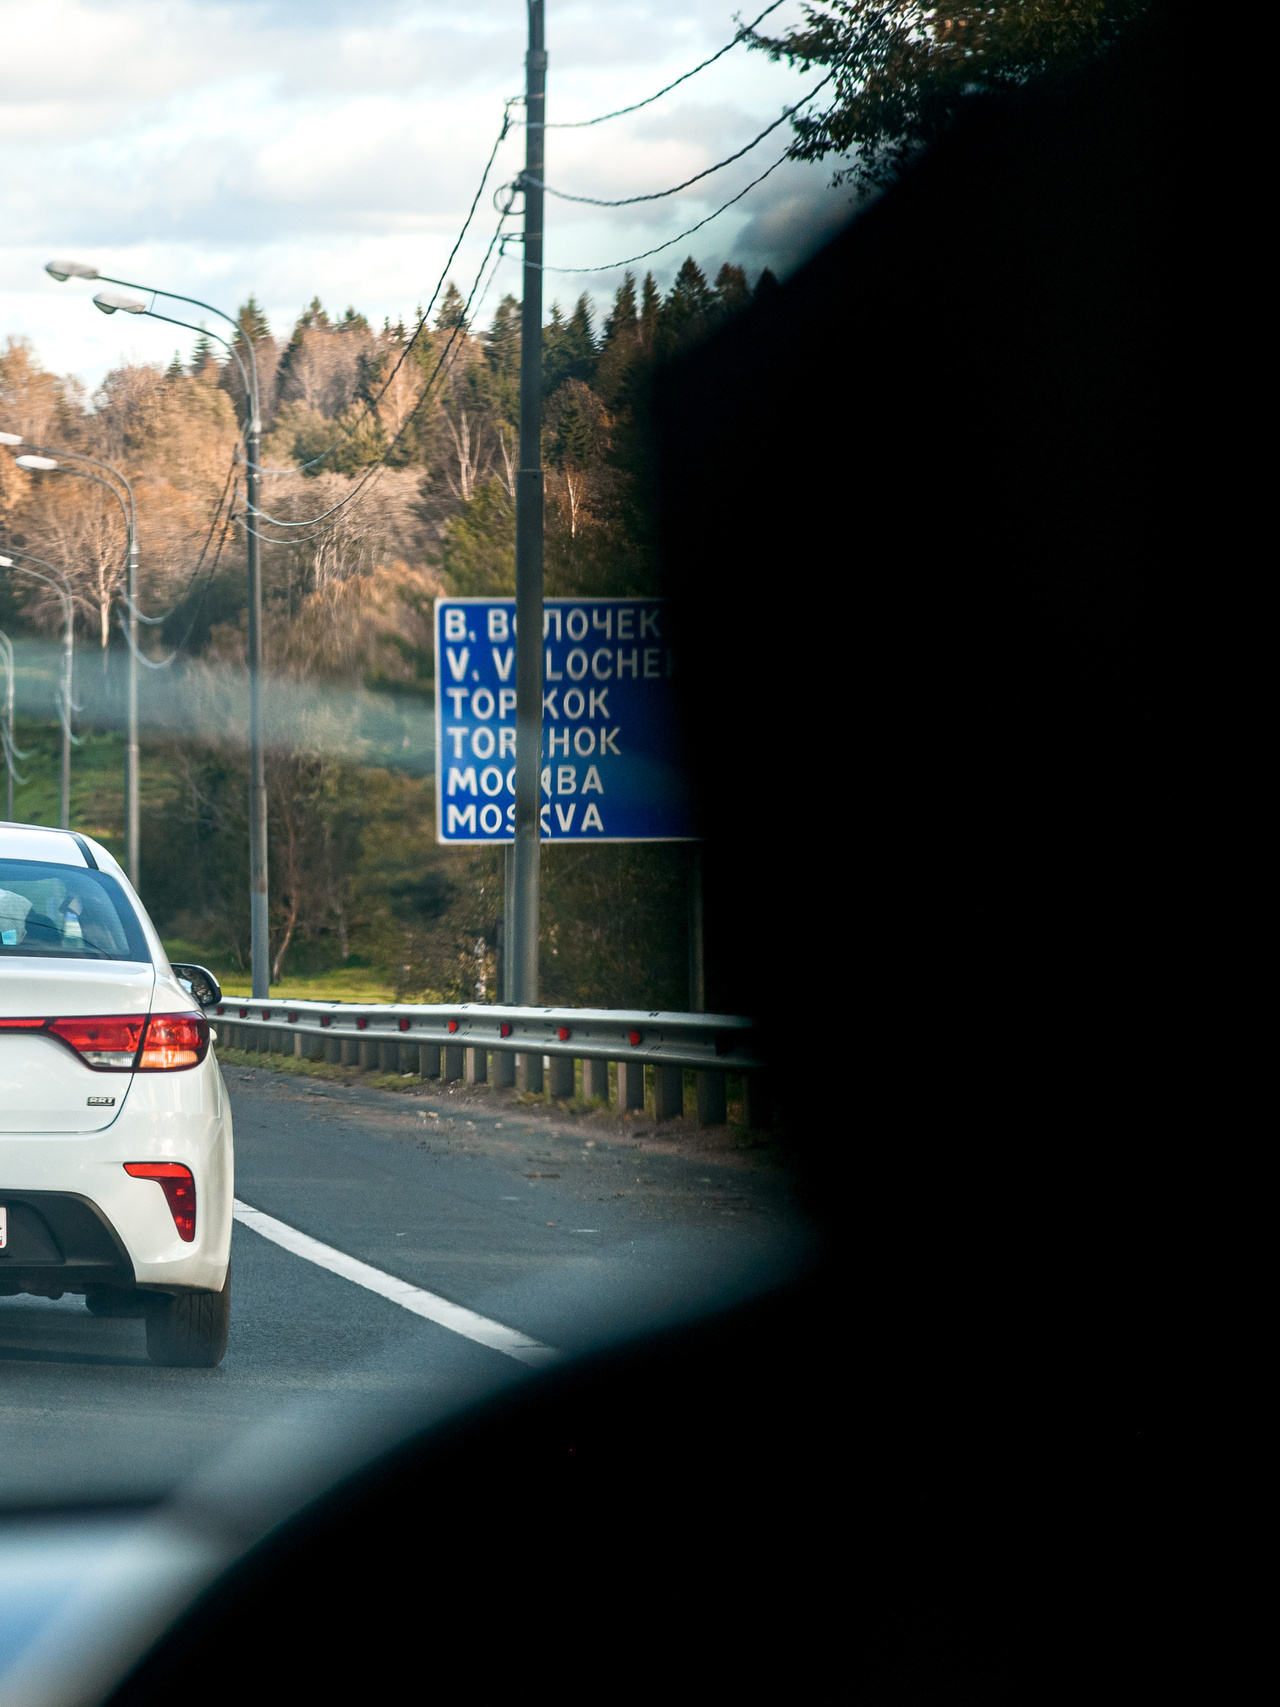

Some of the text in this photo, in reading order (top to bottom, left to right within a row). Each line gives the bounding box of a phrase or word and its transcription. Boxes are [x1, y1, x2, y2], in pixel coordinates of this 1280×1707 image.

[444, 608, 662, 643] В. ВЛОЧЕК
[446, 647, 673, 681] V. VLOCHE
[446, 726, 622, 759] TORHOK
